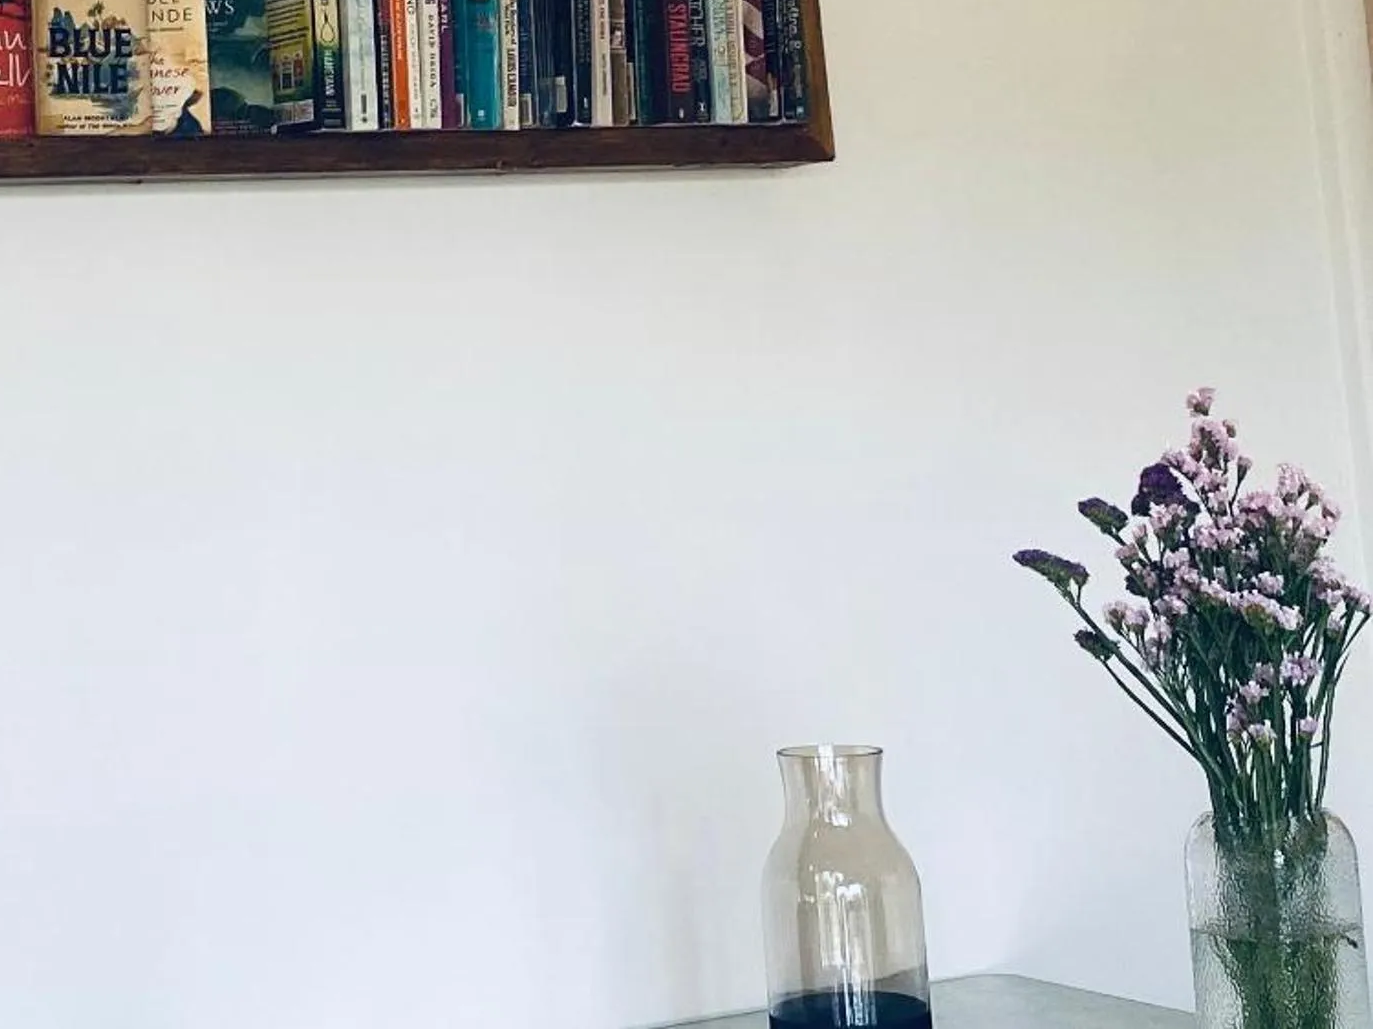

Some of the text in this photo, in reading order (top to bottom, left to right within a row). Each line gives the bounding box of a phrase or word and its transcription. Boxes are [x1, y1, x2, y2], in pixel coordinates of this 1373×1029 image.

[48, 27, 134, 57] BLUE
[668, 3, 690, 94] STALINGRAD
[506, 48, 516, 72] LOUIS
[56, 62, 127, 94] NILE
